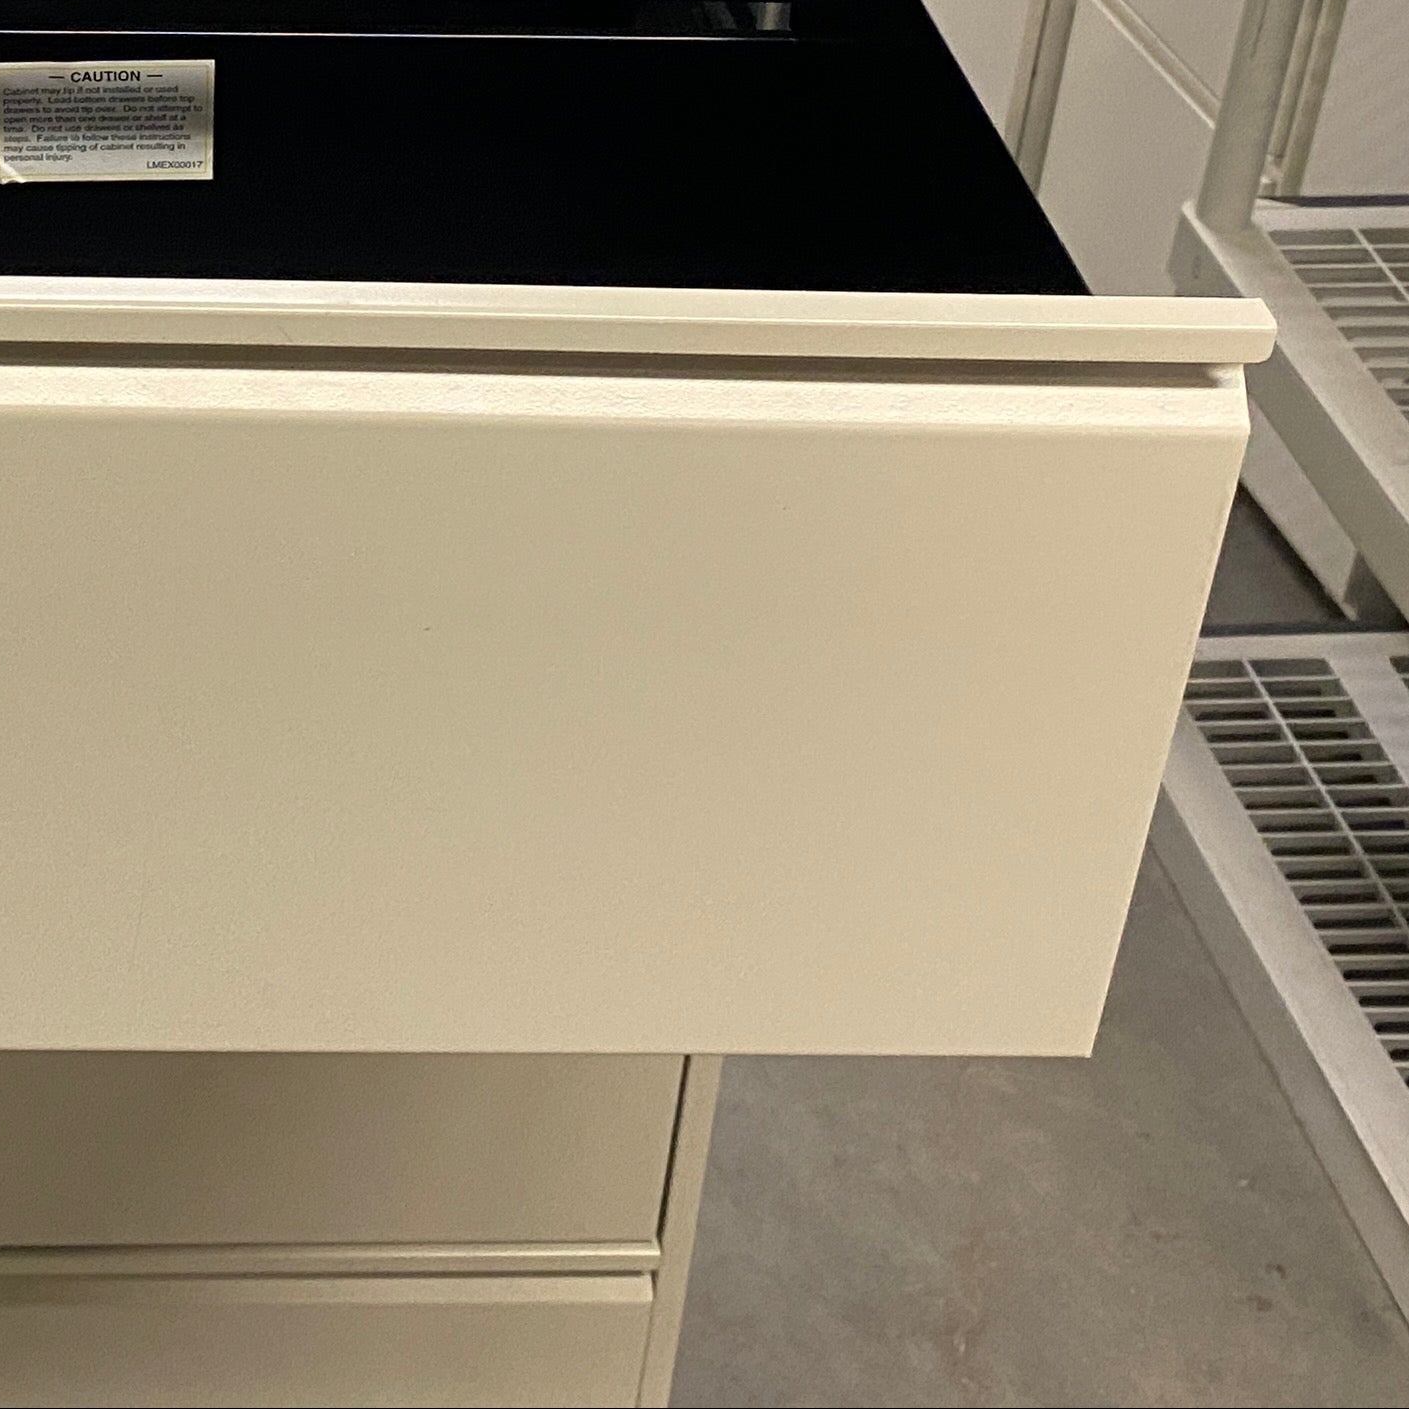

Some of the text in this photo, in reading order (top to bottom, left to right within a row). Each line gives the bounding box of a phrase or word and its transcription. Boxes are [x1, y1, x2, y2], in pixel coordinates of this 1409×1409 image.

[71, 71, 140, 82] CAUTION
[42, 88, 61, 96] may
[156, 85, 178, 93] used
[180, 95, 195, 103] top
[124, 104, 137, 112] Do
[56, 144, 86, 152] tipping
[137, 143, 174, 151] resulting
[4, 154, 43, 162] personal
